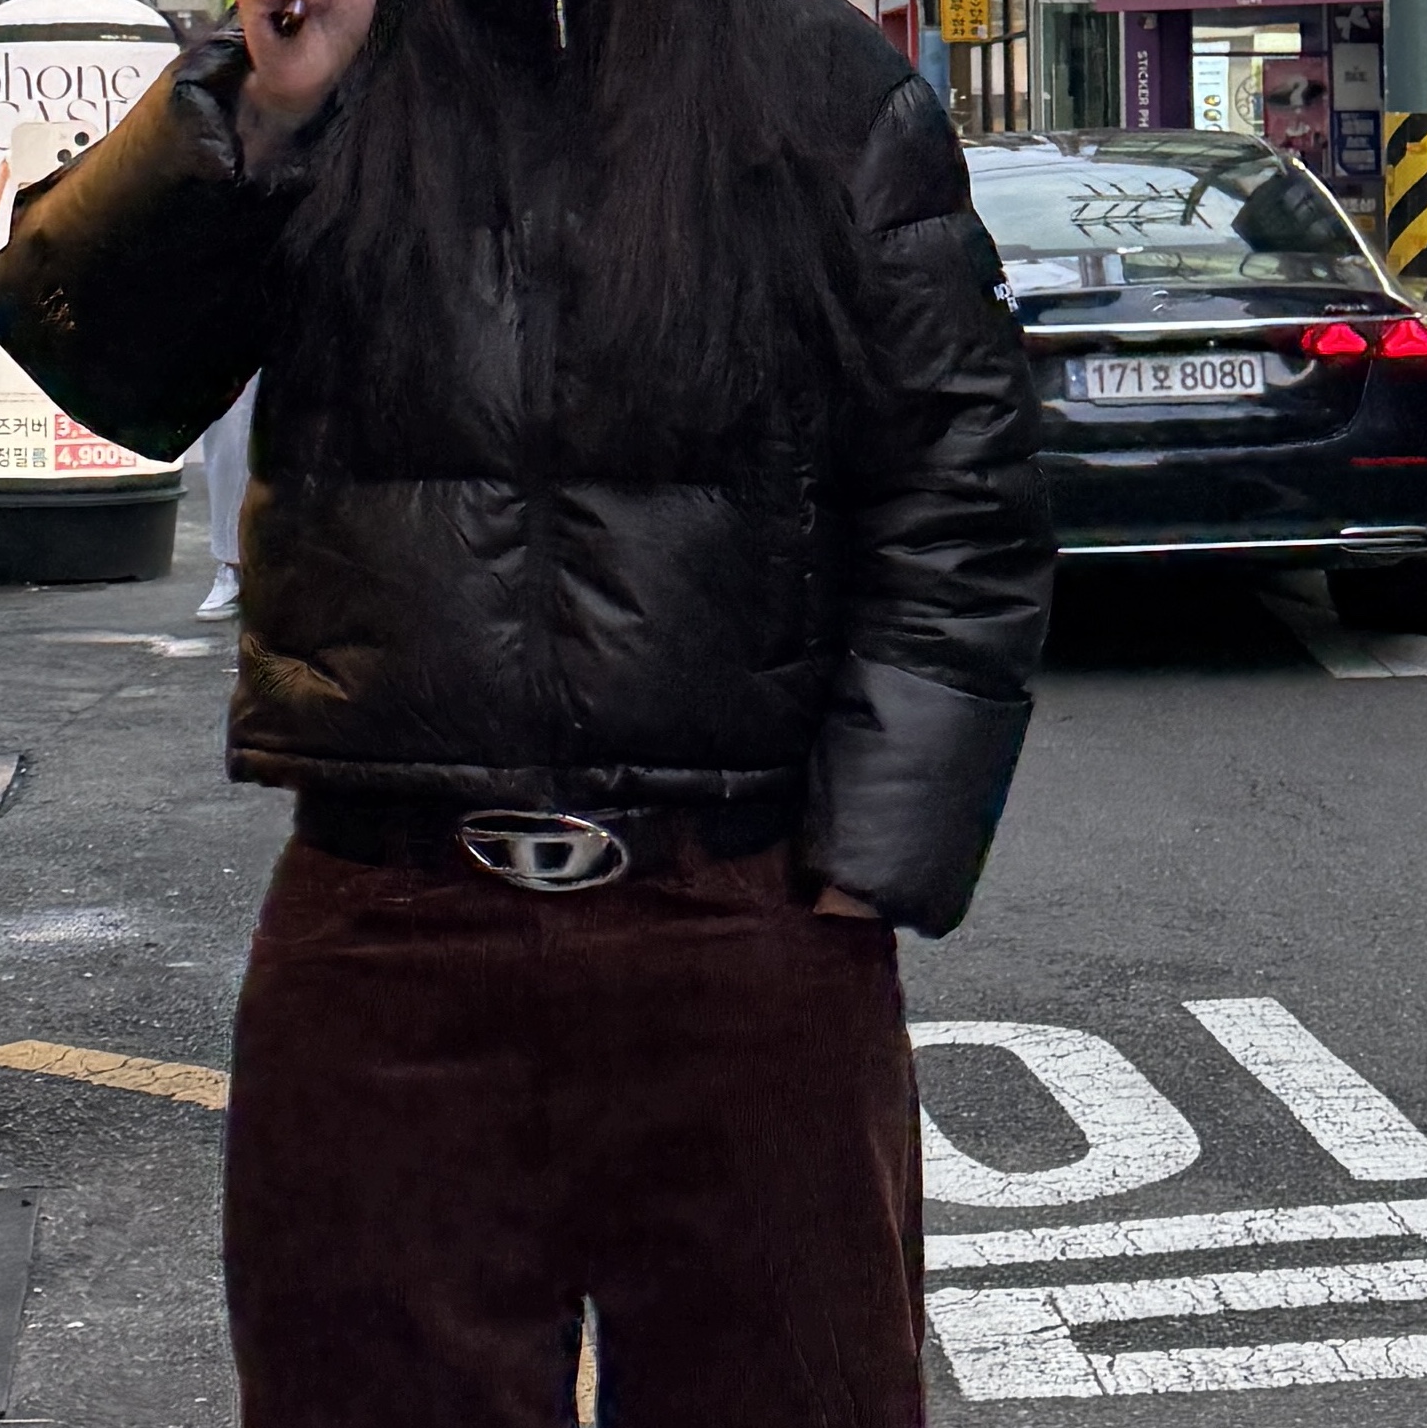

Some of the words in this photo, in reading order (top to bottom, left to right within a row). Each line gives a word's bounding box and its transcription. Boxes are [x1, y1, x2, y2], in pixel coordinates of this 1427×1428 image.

[1136, 50, 1150, 106] STICKER
[1137, 109, 1150, 129] PH
[1179, 357, 1258, 392] 8080
